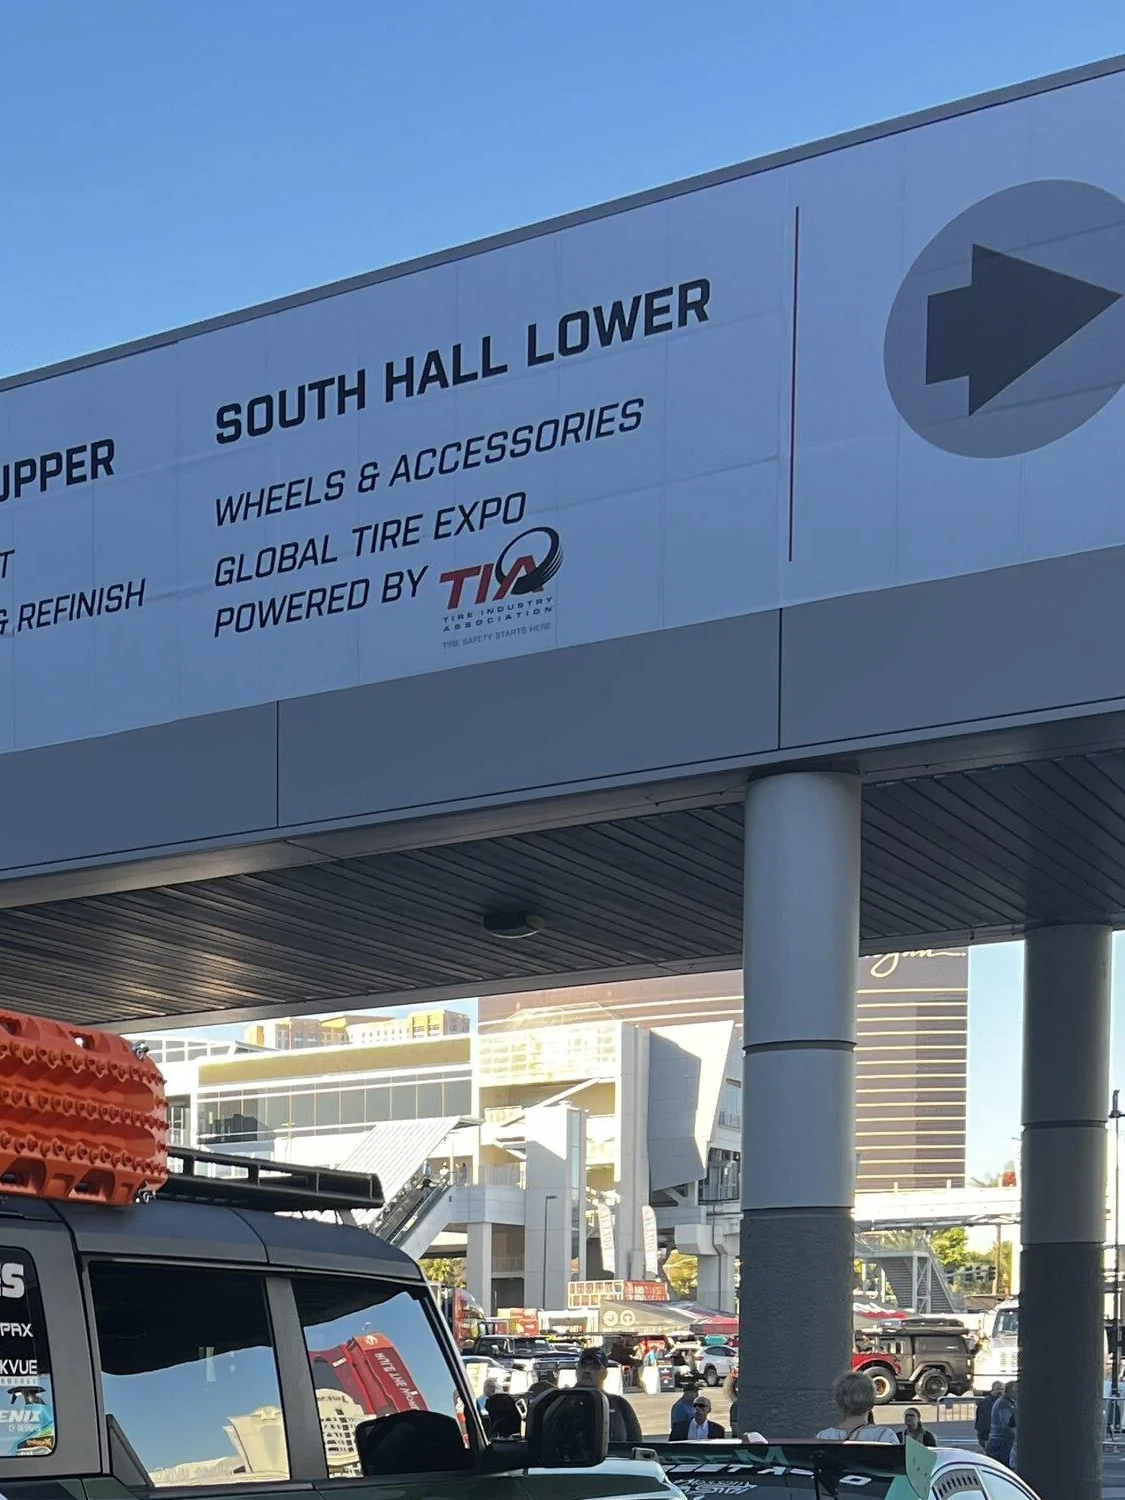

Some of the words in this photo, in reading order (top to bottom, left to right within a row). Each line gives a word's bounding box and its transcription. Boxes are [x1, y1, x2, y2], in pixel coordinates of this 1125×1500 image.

[215, 369, 366, 445] SOUTH
[385, 335, 508, 402] HALL
[527, 278, 711, 367] LOWER
[215, 469, 346, 527] WHEELS
[358, 461, 380, 493] &
[389, 398, 644, 487] ACCESSORIES
[214, 535, 338, 587] GLOBAL
[352, 514, 424, 557] TIRE
[434, 492, 527, 540] EXPO
[17, 578, 146, 633] REFINISH
[214, 578, 370, 638] POWERED
[381, 565, 429, 603] BY
[439, 553, 545, 610] TIA
[443, 613, 474, 624] TIRE
[480, 597, 554, 616] INDUSTRY
[443, 606, 553, 633] ASSOCIATION
[443, 640, 460, 649] TIRE
[462, 633, 494, 646] SAFETY
[495, 626, 528, 641] STARTS
[529, 622, 552, 633] HERE
